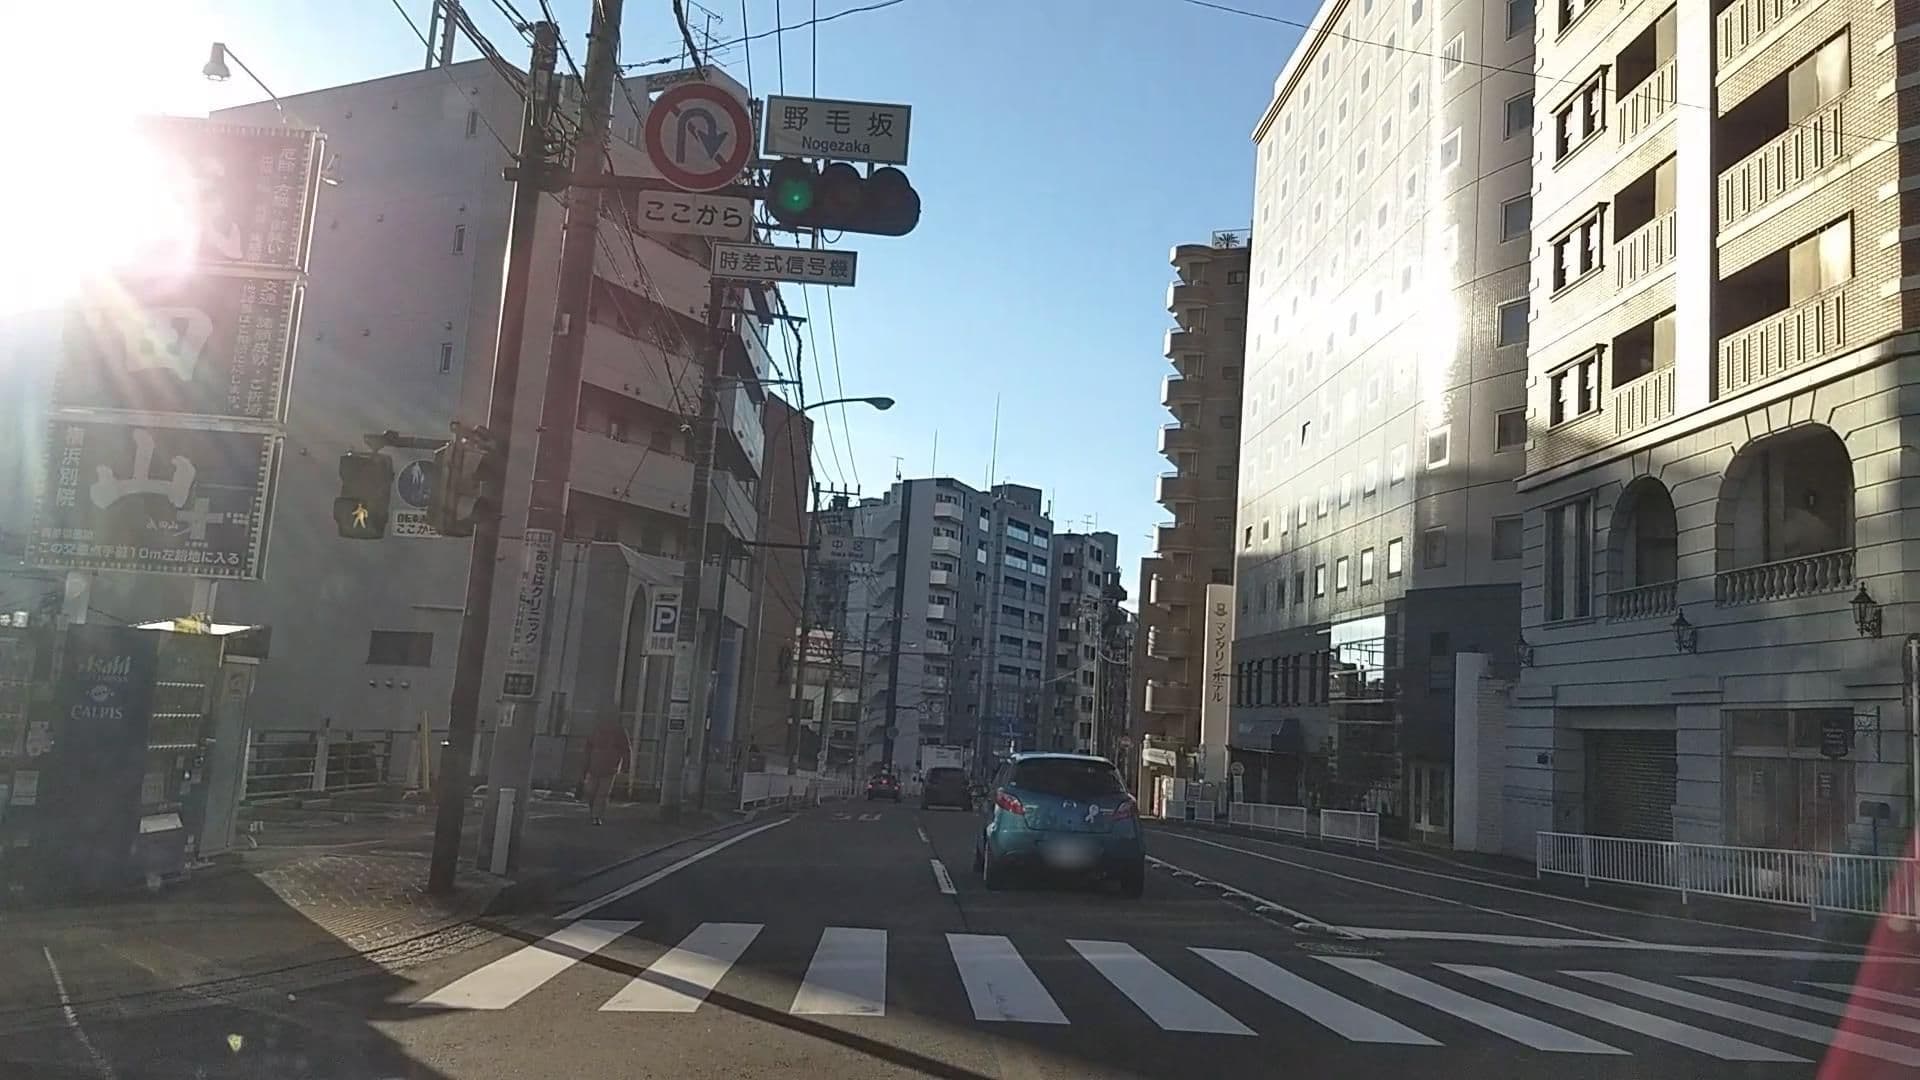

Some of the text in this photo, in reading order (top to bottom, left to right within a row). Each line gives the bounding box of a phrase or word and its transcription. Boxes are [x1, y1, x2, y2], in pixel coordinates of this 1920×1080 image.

[783, 105, 894, 138] 野毛坂
[801, 136, 871, 154] Nogezaka
[645, 200, 743, 228] ここから
[719, 250, 849, 278] 時差式信号機
[656, 607, 676, 631] P
